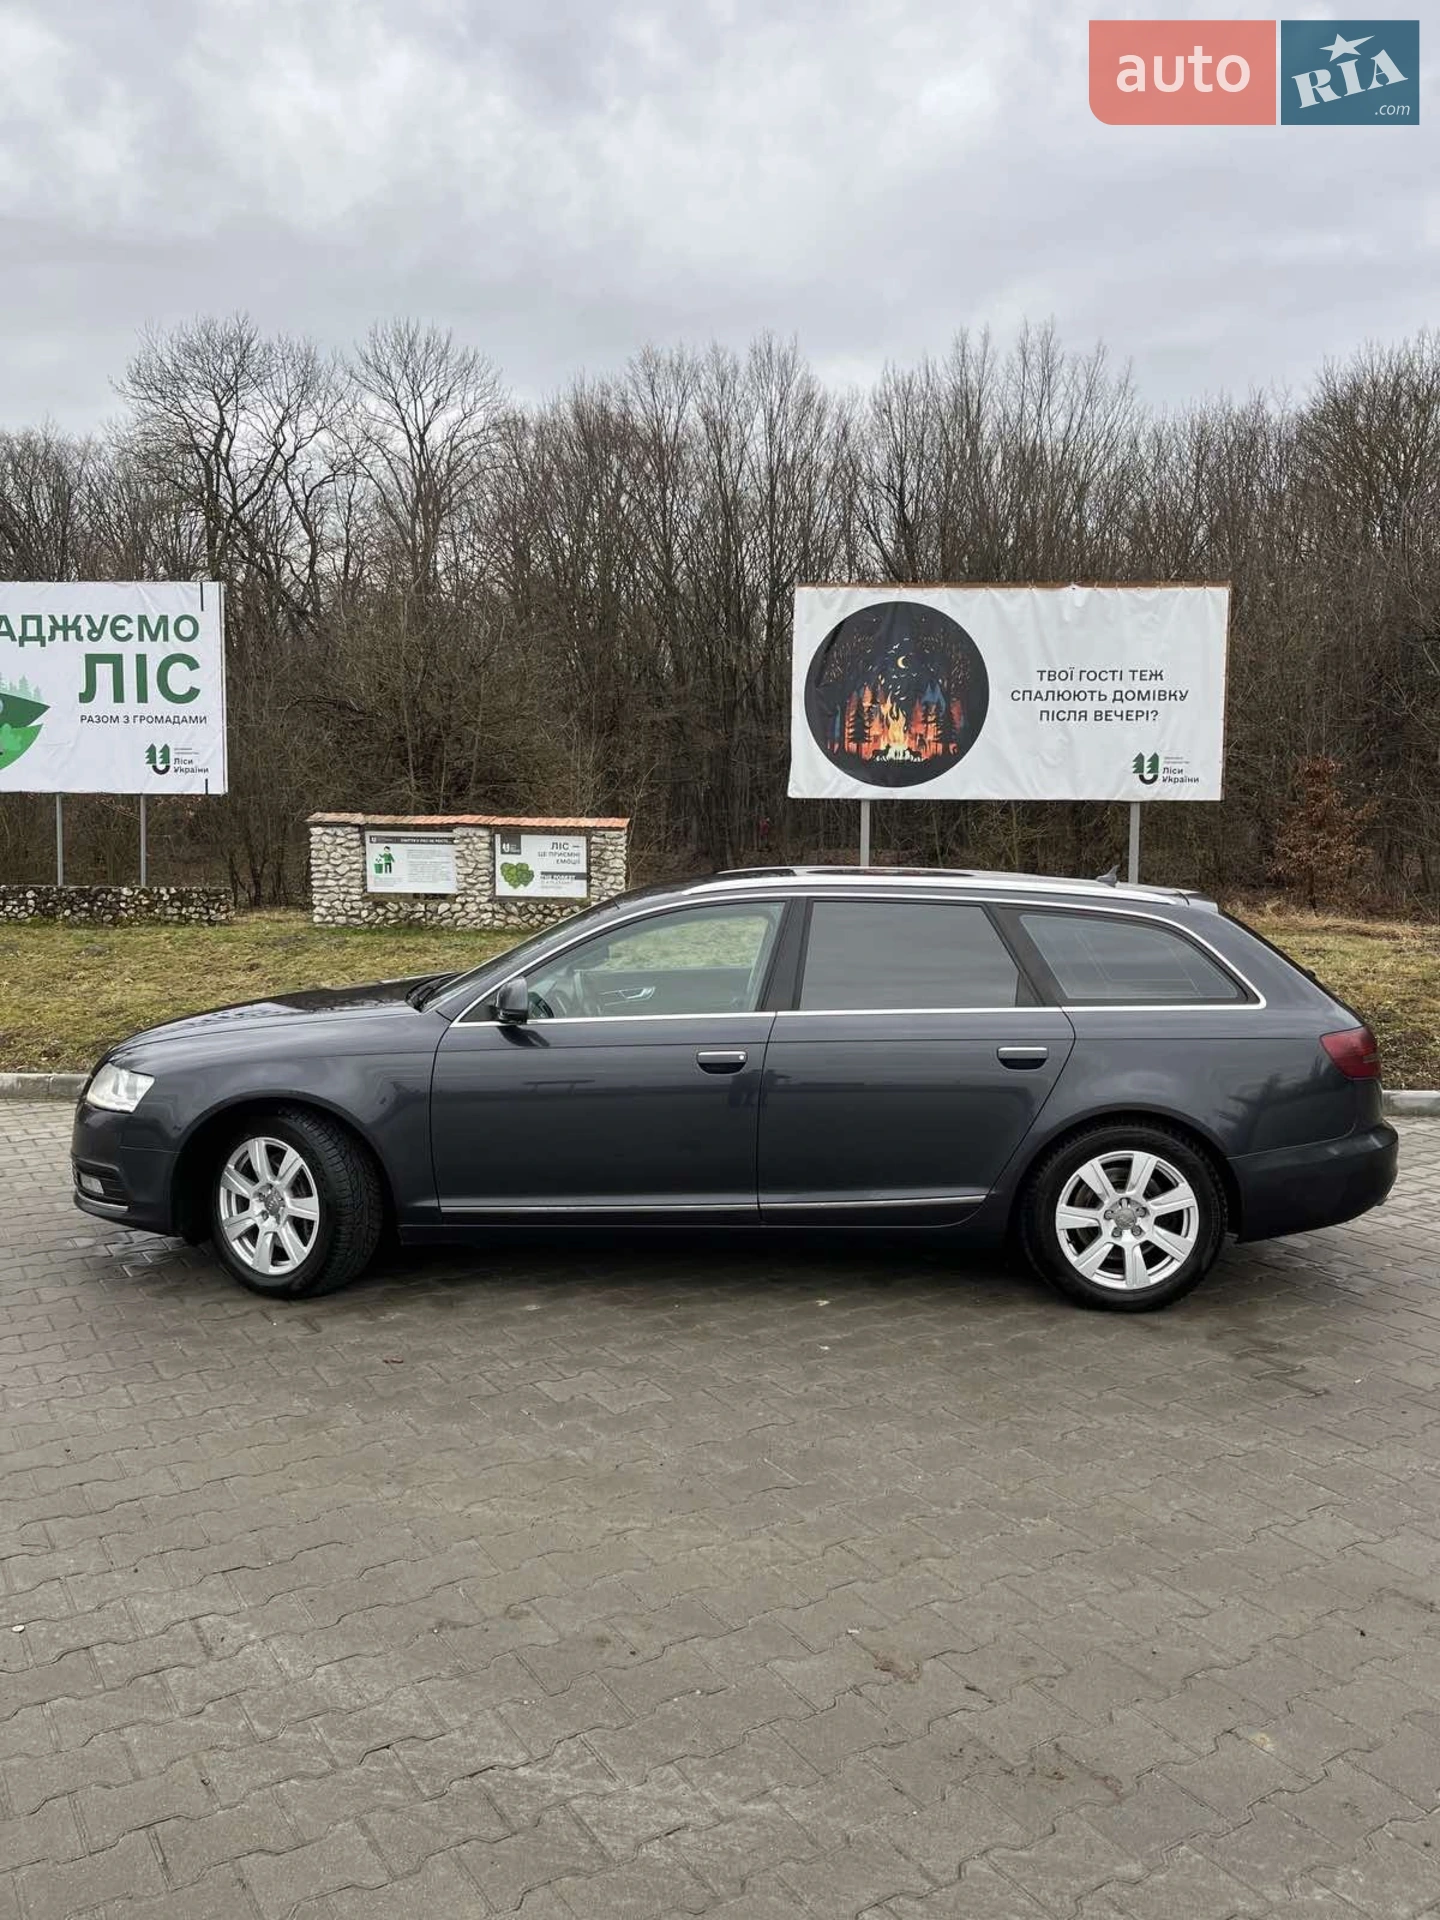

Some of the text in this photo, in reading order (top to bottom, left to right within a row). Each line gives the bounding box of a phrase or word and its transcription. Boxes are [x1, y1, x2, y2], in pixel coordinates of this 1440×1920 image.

[78, 653, 201, 704] ЛІС
[1036, 667, 1164, 682] ТВОЇ ГОСТІ ТЕЖ
[1010, 690, 1190, 704] СПАЛЮЮТЬ ДОМІВКУ
[80, 714, 208, 726] РАЗОМ З ГРОМАДАМИ
[1039, 709, 1159, 722] ПІСЛЯ ВЕЧЕРІ?
[1162, 767, 1184, 775] Ліси
[1162, 775, 1200, 784] України
[551, 841, 569, 851] ЛІС
